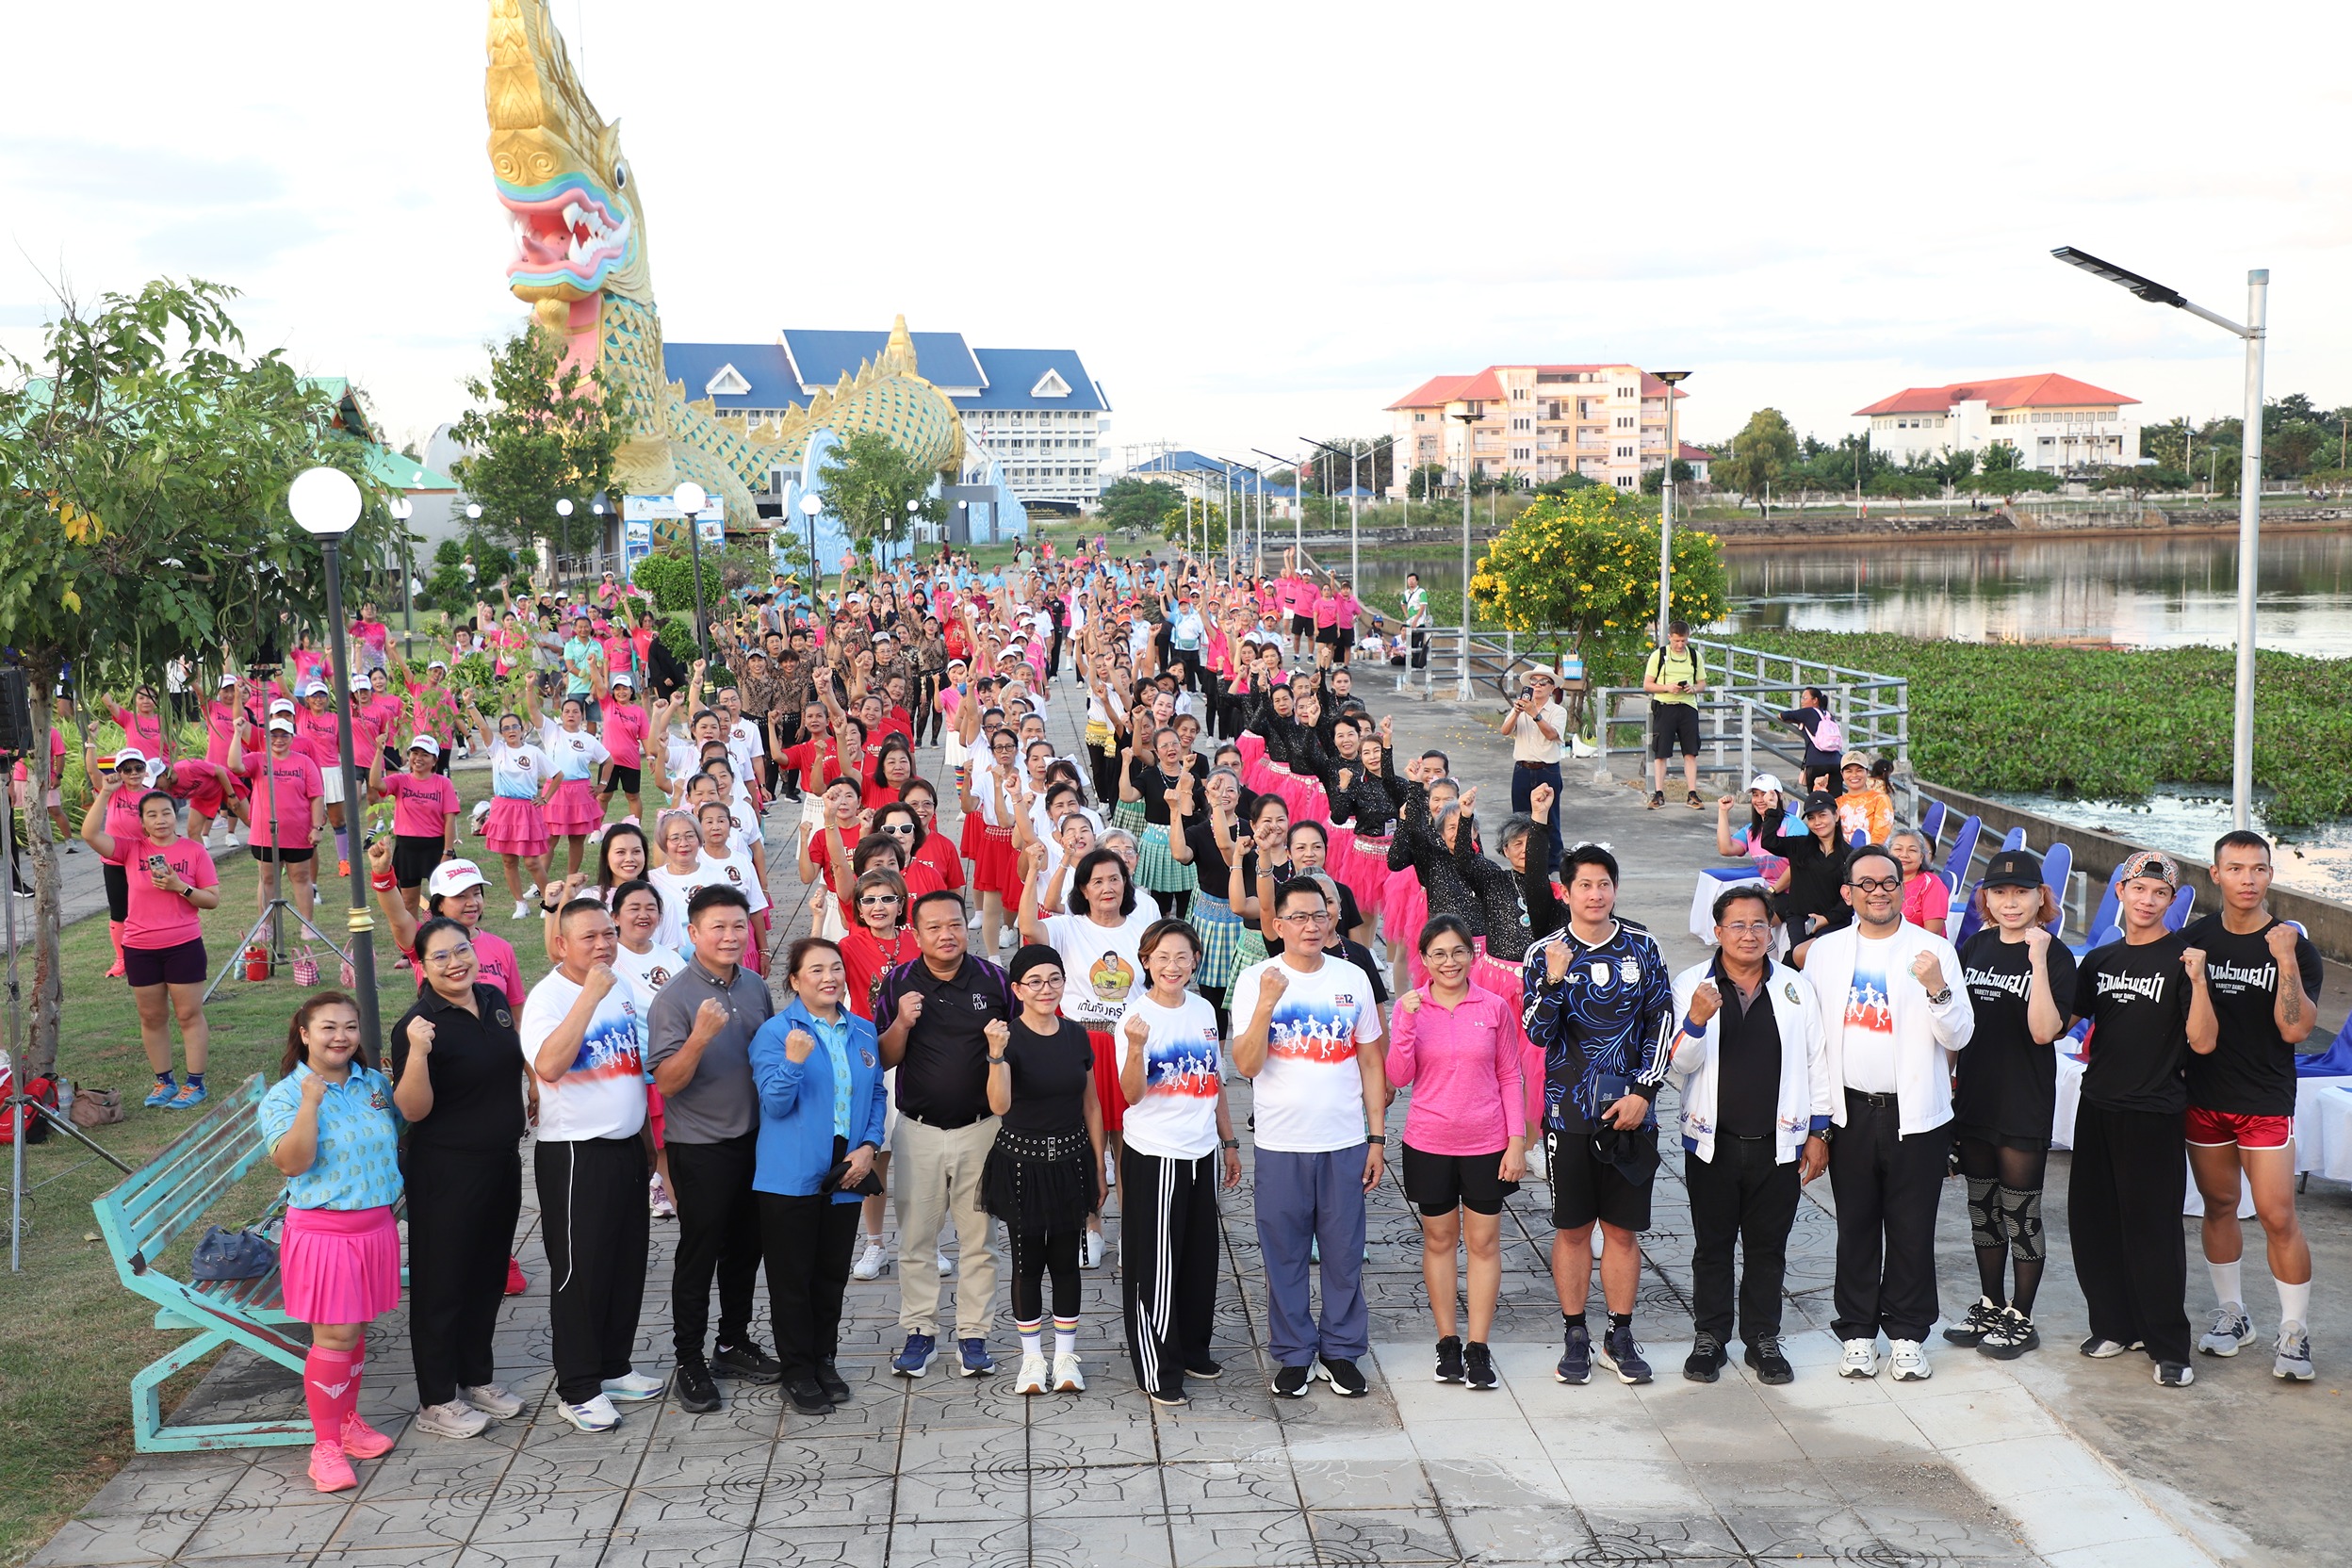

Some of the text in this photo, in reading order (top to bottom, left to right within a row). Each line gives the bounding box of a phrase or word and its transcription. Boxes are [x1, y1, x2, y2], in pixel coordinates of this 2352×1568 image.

[1965, 966, 2033, 1002] อนฟอนเฒ่า
[1344, 994, 1354, 1004] 12
